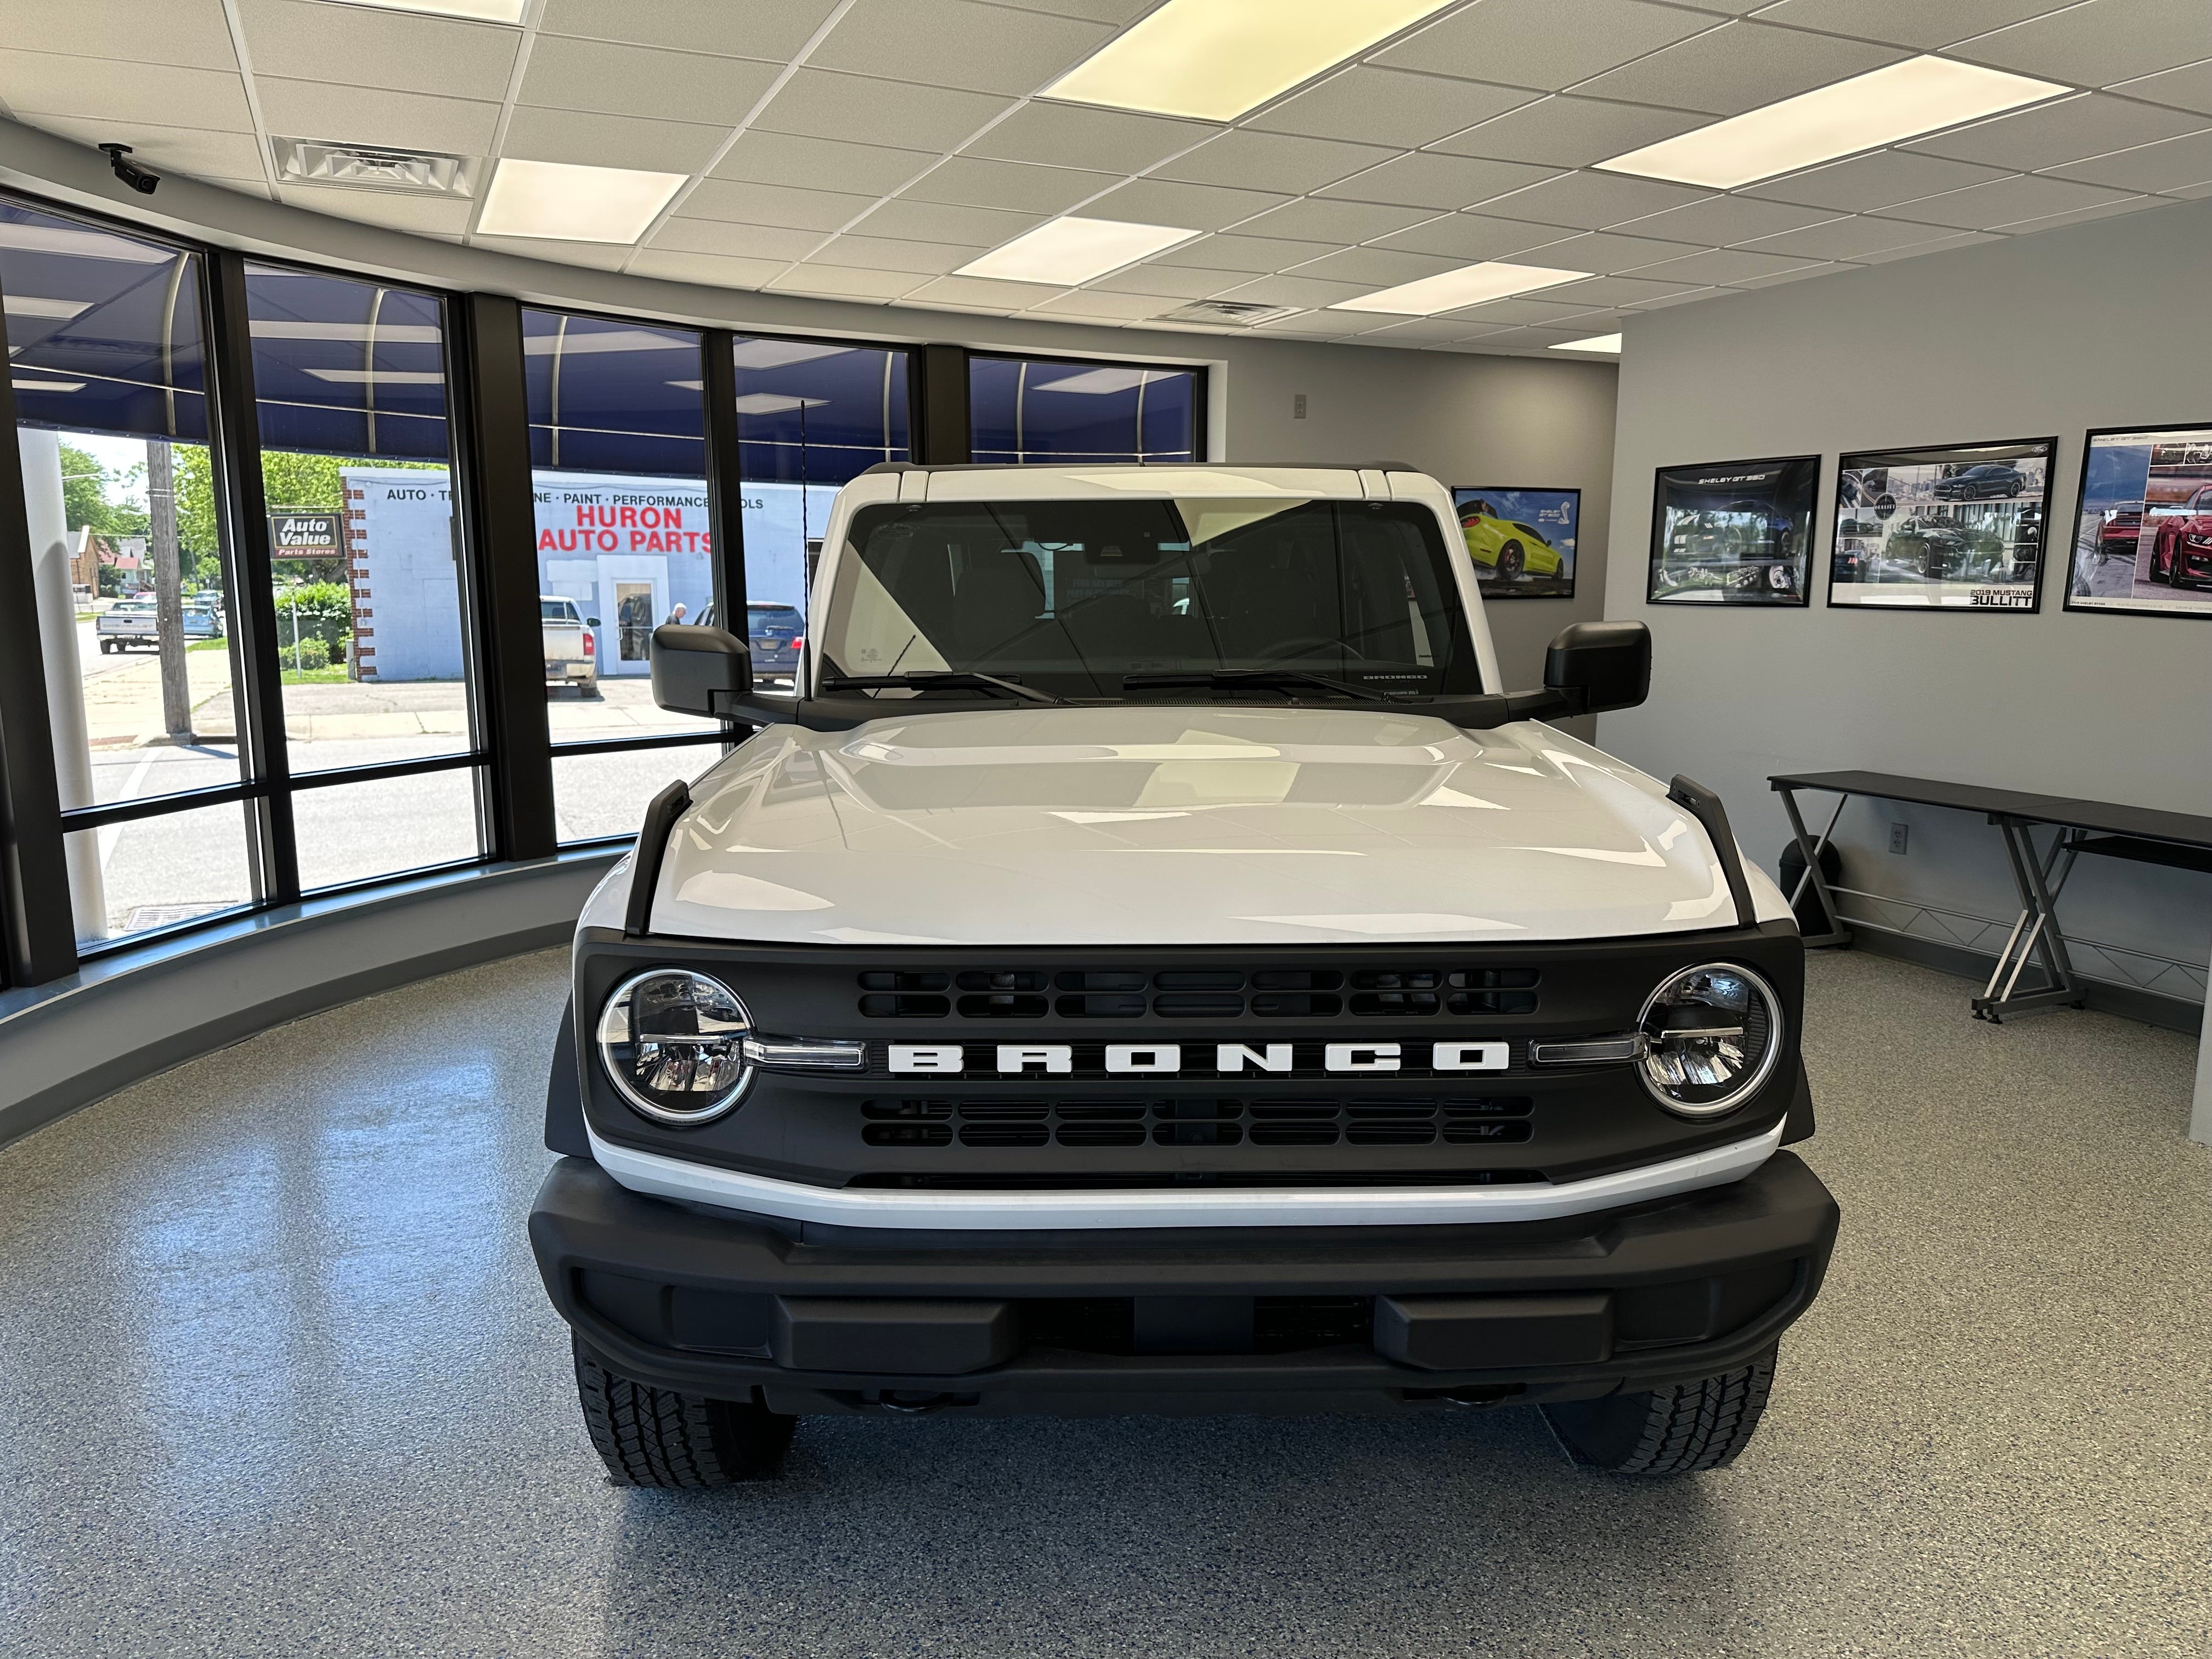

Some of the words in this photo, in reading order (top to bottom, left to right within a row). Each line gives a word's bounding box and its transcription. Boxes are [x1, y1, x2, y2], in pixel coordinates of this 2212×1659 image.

[387, 489, 426, 500] AUTO
[564, 493, 602, 504] PAINT
[613, 495, 708, 507] PERFORMANCE
[282, 518, 327, 532] Auto
[577, 505, 682, 529] HURON
[279, 532, 331, 546] Value
[538, 529, 619, 552] AUTO
[630, 530, 710, 554] PARTS
[1970, 595, 2032, 606] BULLITT
[887, 1042, 1510, 1074] BRONCO
